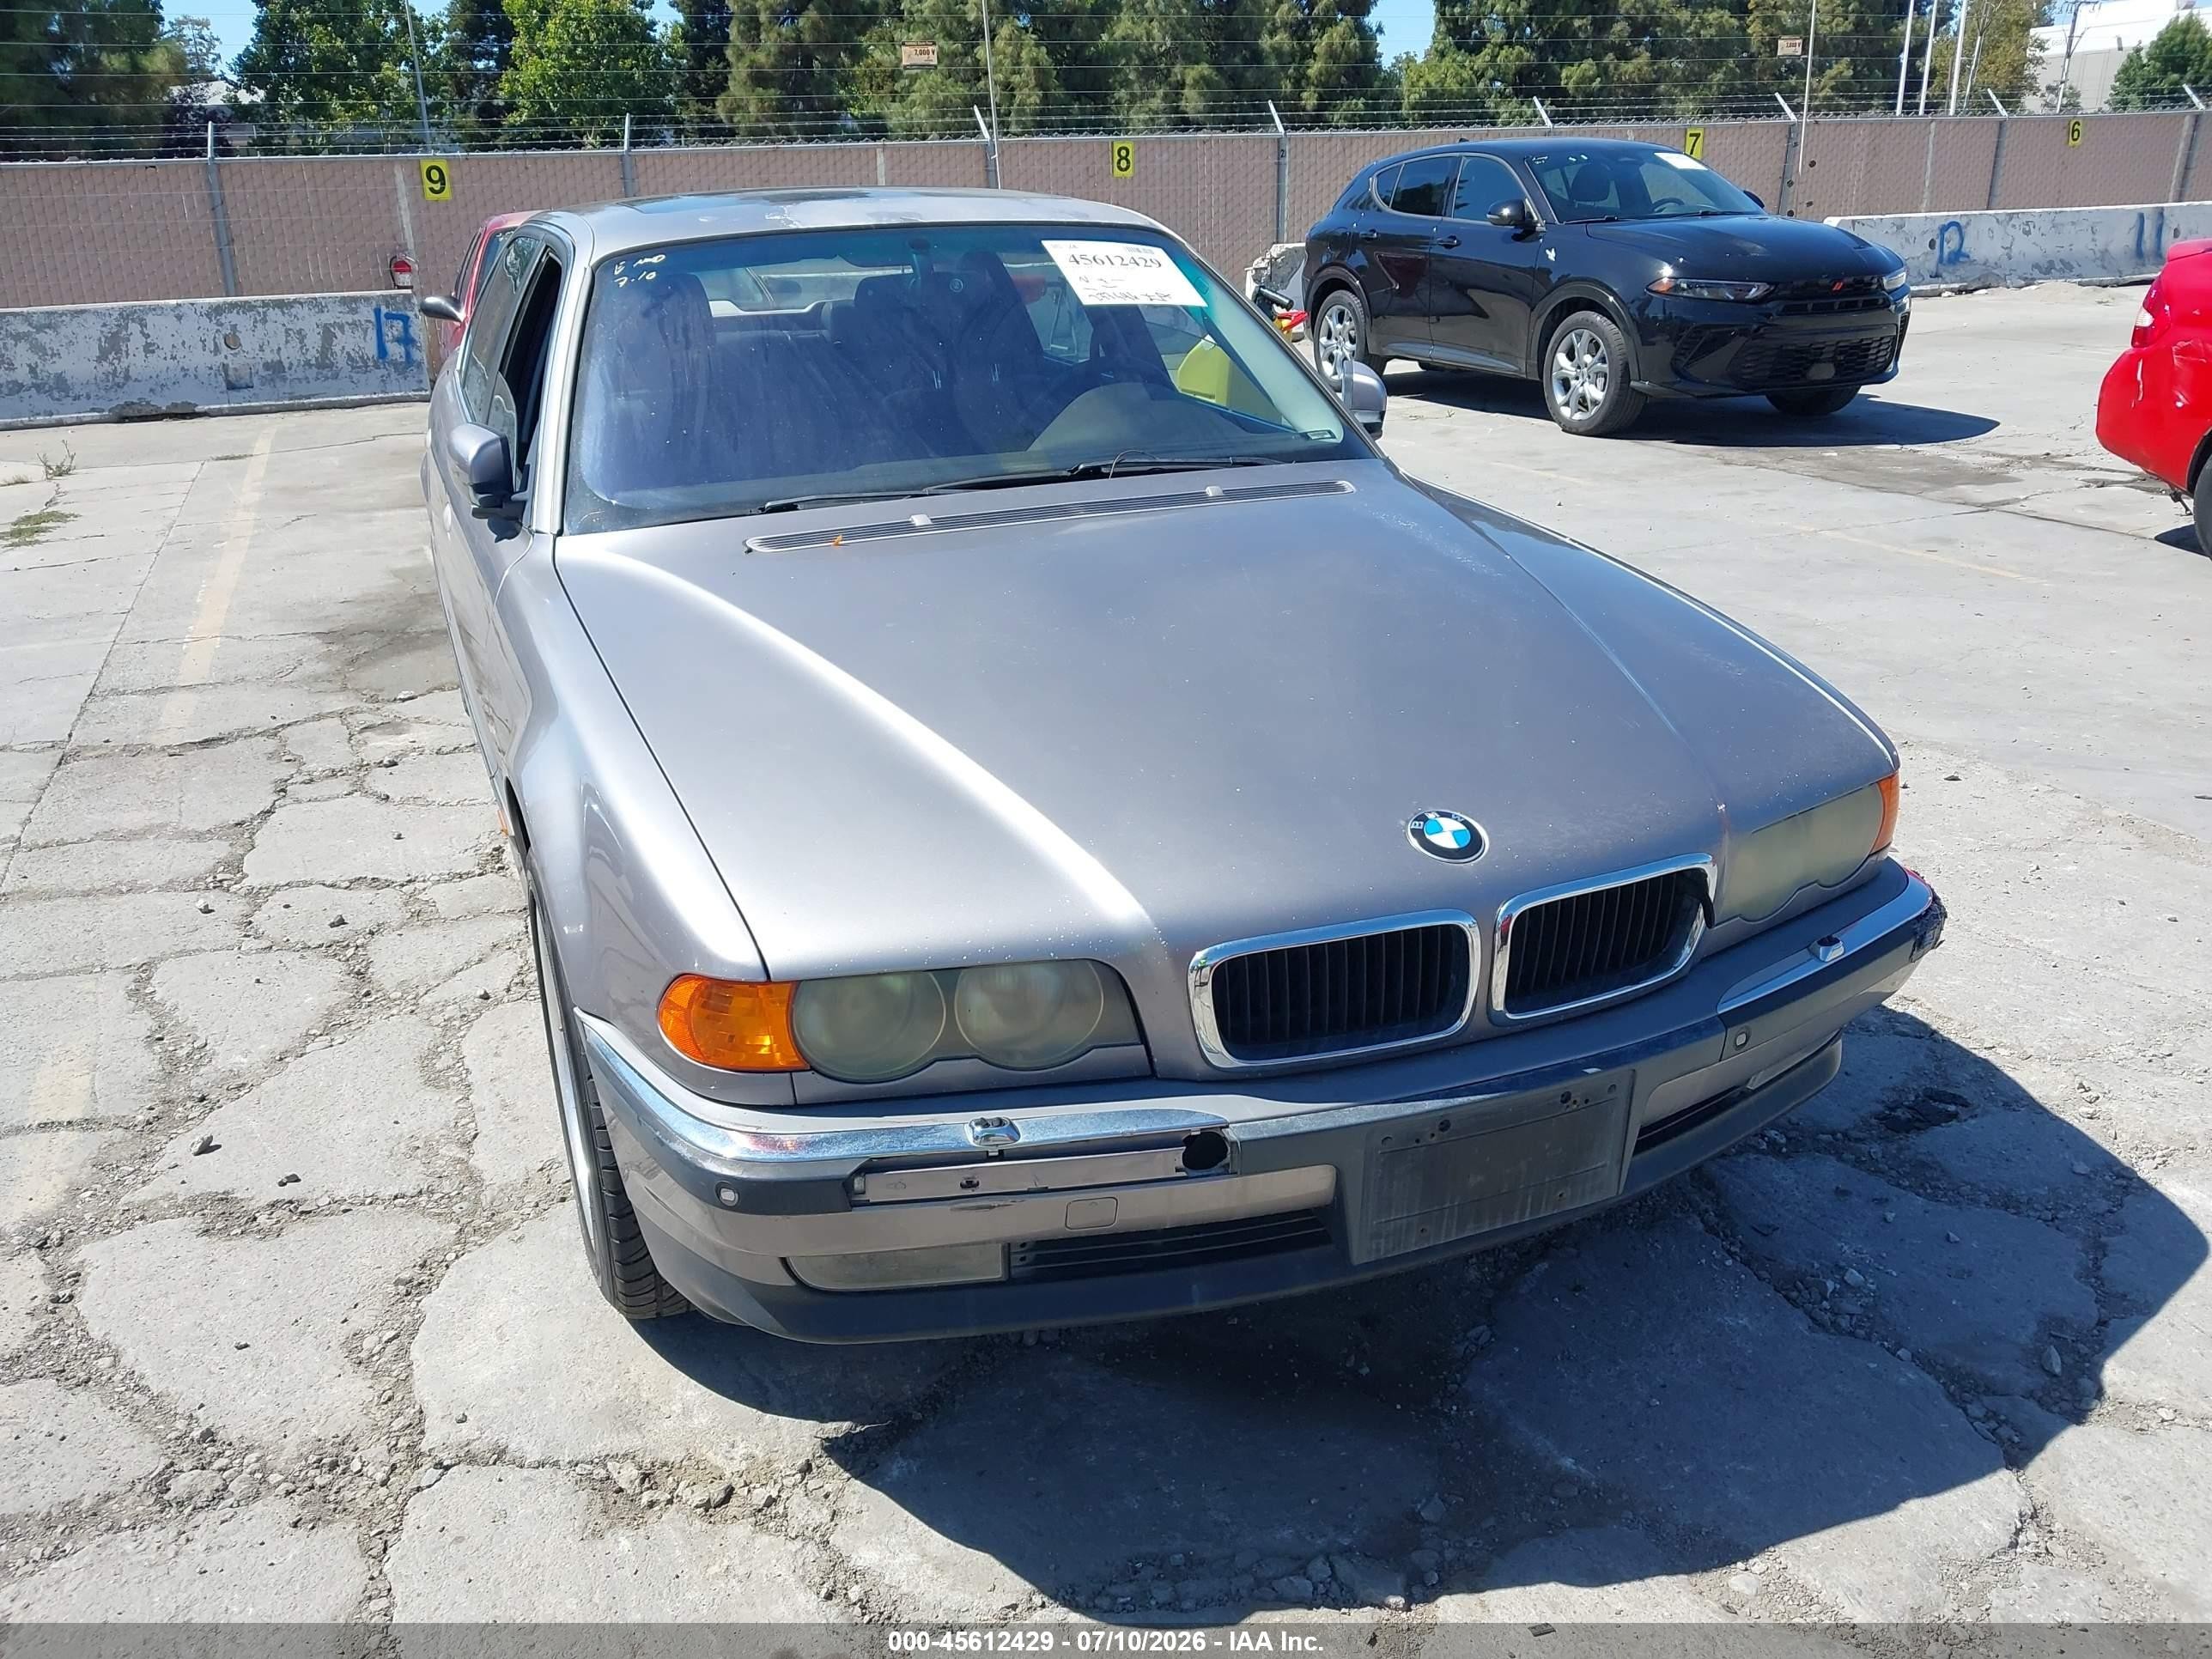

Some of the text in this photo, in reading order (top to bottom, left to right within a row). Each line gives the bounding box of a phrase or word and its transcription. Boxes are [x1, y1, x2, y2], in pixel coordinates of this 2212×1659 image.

[2071, 120, 2081, 142] 6
[1689, 132, 1701, 155] 7
[1116, 146, 1131, 173] 8
[425, 165, 447, 195] 9
[1068, 253, 1162, 268] 45612429
[374, 307, 418, 364] 17
[1410, 811, 1464, 830] BMW
